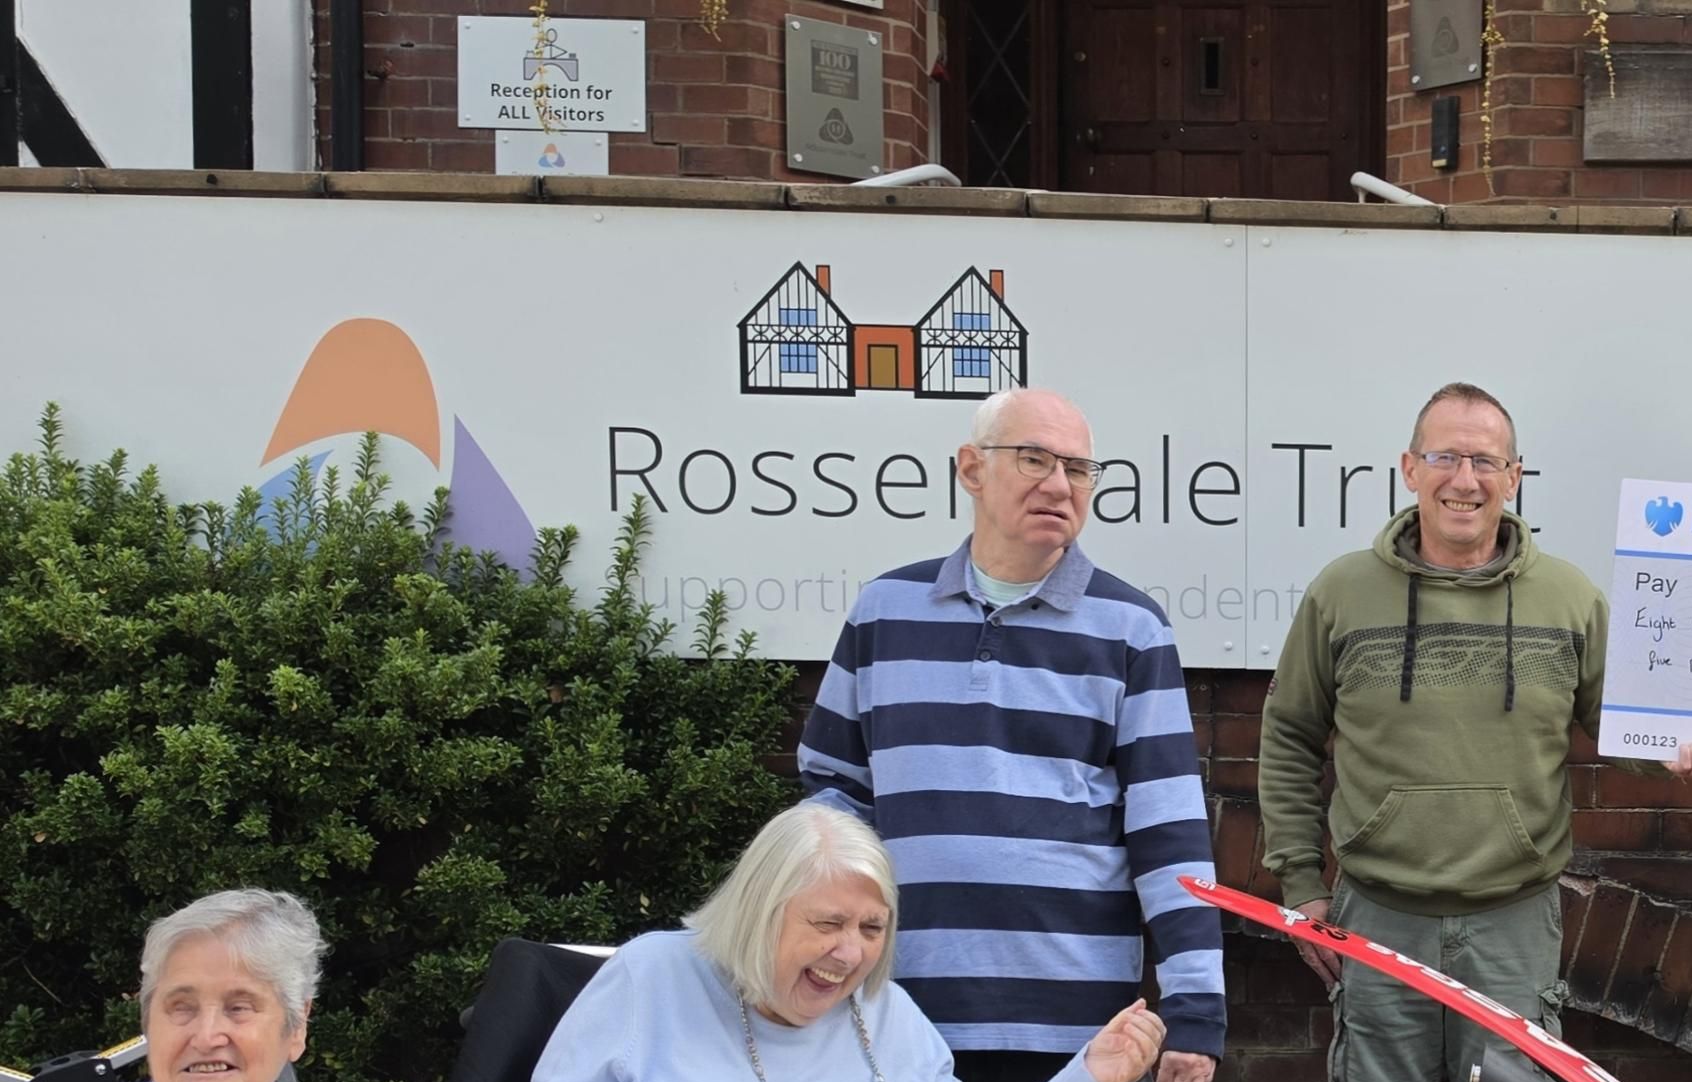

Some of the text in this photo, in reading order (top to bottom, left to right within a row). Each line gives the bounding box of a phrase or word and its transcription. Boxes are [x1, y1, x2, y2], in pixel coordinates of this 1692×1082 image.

[491, 83, 613, 100] Reception for
[498, 105, 605, 121] ALL Visitors
[607, 425, 1541, 533] Rosseale Trt
[1635, 572, 1678, 598] Pay
[1635, 607, 1676, 642] Eight
[1649, 650, 1672, 671] five
[1623, 733, 1678, 748] 000123
